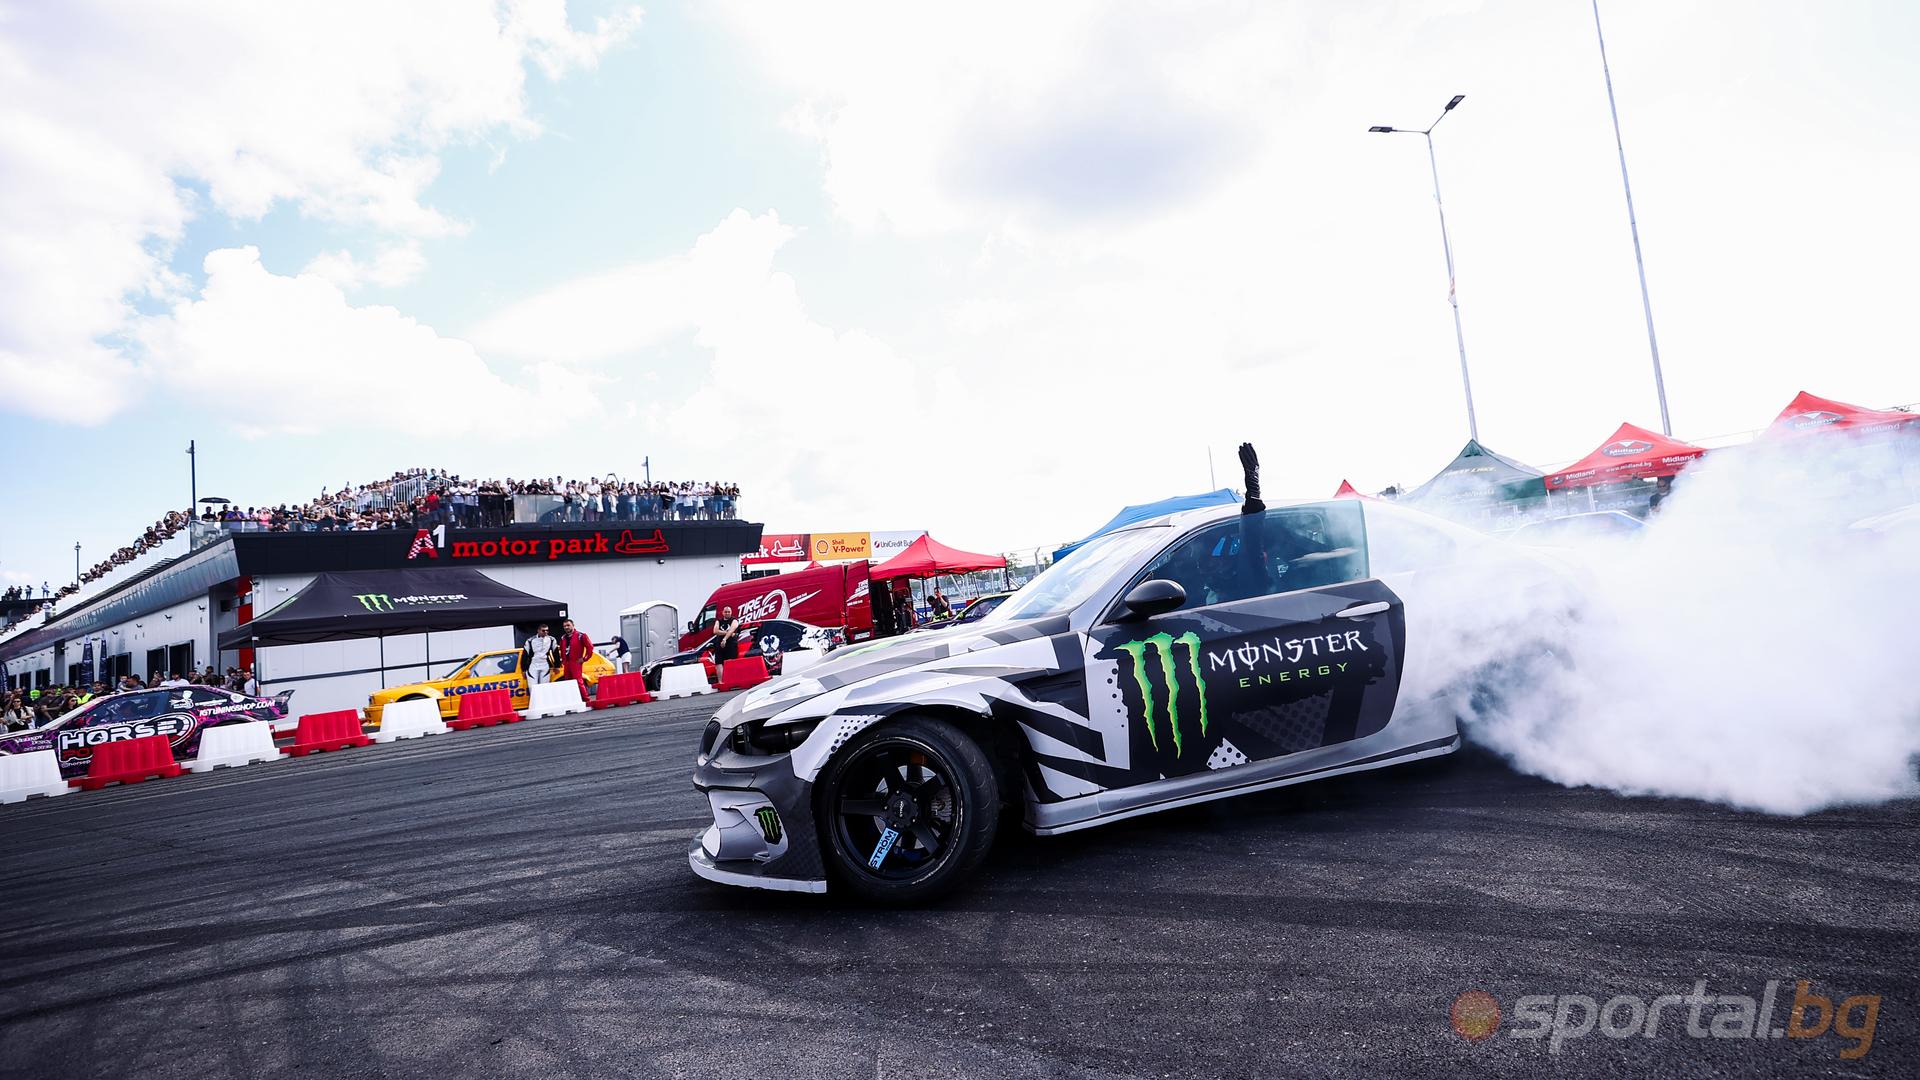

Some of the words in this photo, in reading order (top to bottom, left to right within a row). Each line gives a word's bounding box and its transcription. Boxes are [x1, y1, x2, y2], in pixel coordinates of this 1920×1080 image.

[1662, 454, 1696, 464] Midland
[1566, 469, 1596, 480] Midland
[452, 537, 541, 558] motor
[549, 532, 609, 560] park
[880, 540, 903, 549] UniCredit
[393, 594, 469, 604] MONSTER
[737, 595, 764, 617] TIRE
[737, 600, 778, 625] ERVICE
[1208, 630, 1369, 673] MONSTER
[1239, 662, 1348, 689] ENERGY
[443, 679, 520, 698] KOMATSU
[61, 719, 178, 750] HORSE
